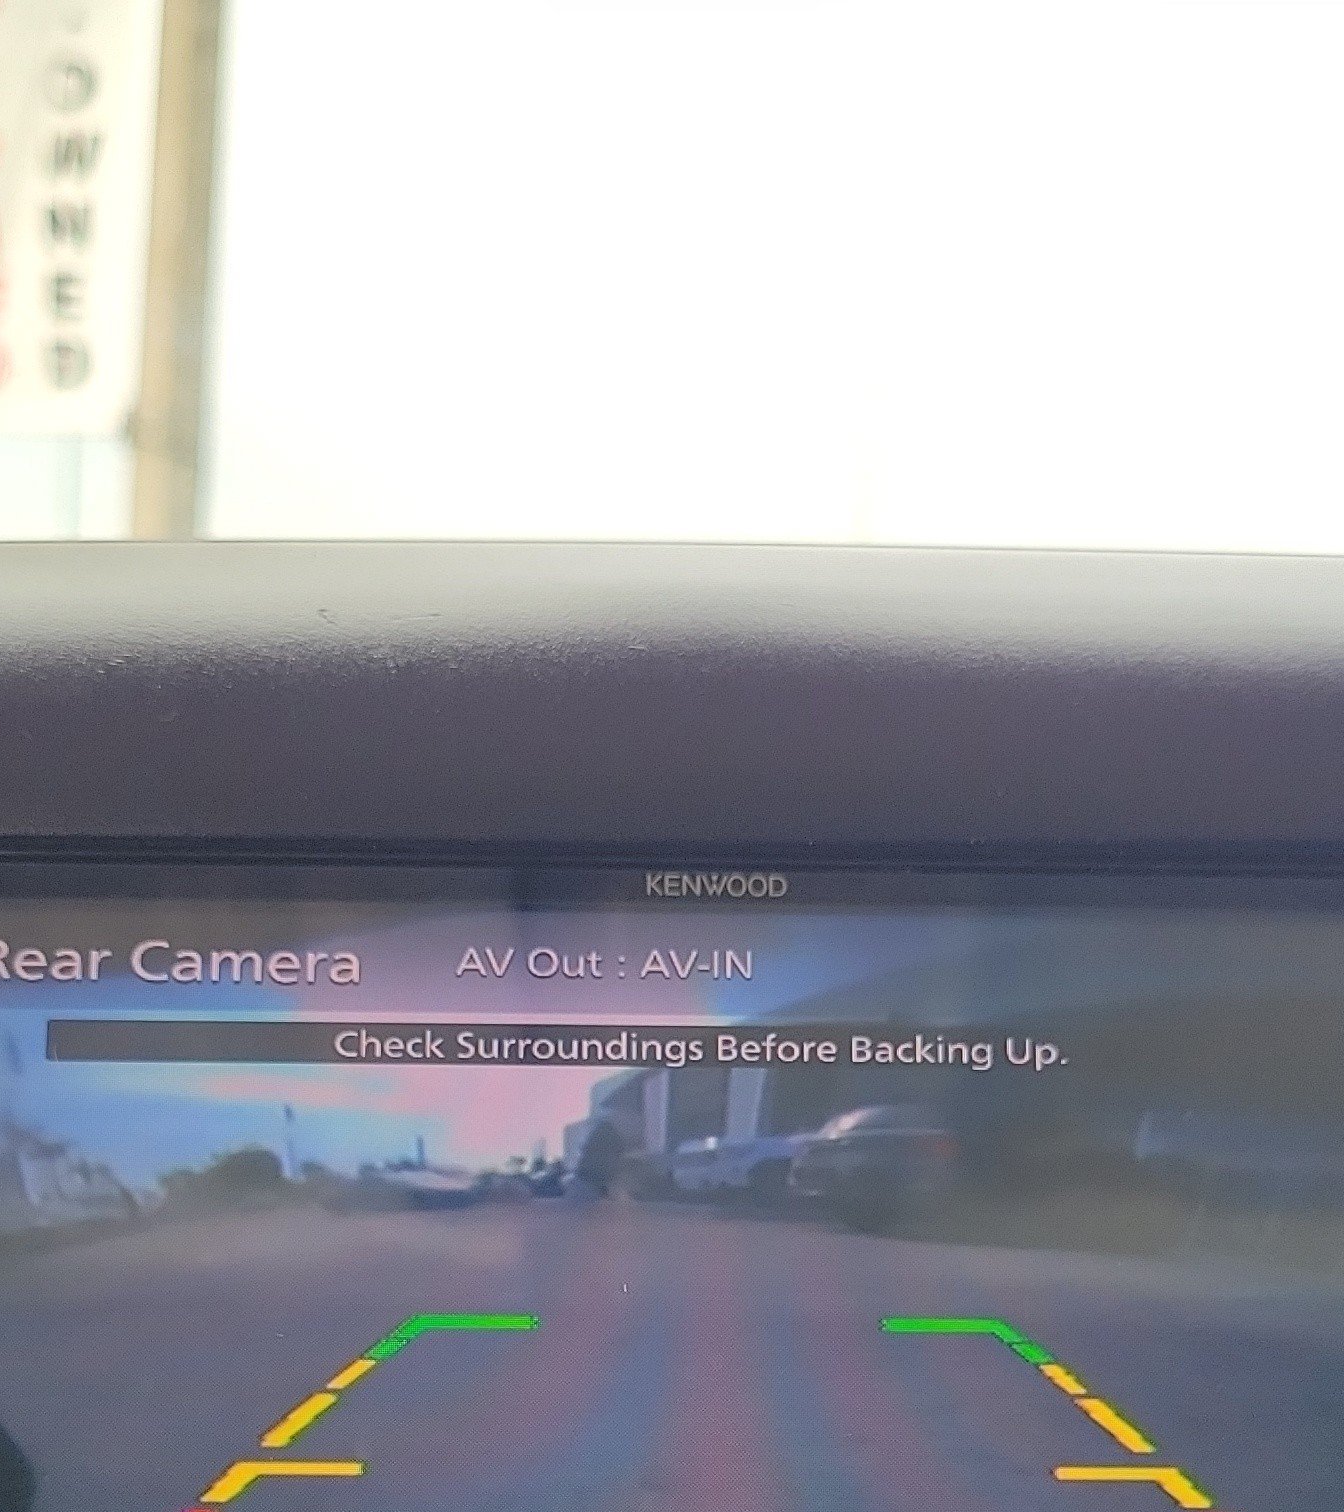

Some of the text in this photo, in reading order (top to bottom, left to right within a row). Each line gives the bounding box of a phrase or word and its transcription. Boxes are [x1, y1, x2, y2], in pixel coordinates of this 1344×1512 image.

[644, 872, 789, 899] KENWOOD
[130, 938, 364, 986] Camera
[455, 947, 515, 979] AV
[525, 947, 611, 980] Out
[639, 948, 755, 981] AV-IN
[333, 1028, 1071, 1071] Check Surroundings Before Backing Up.
